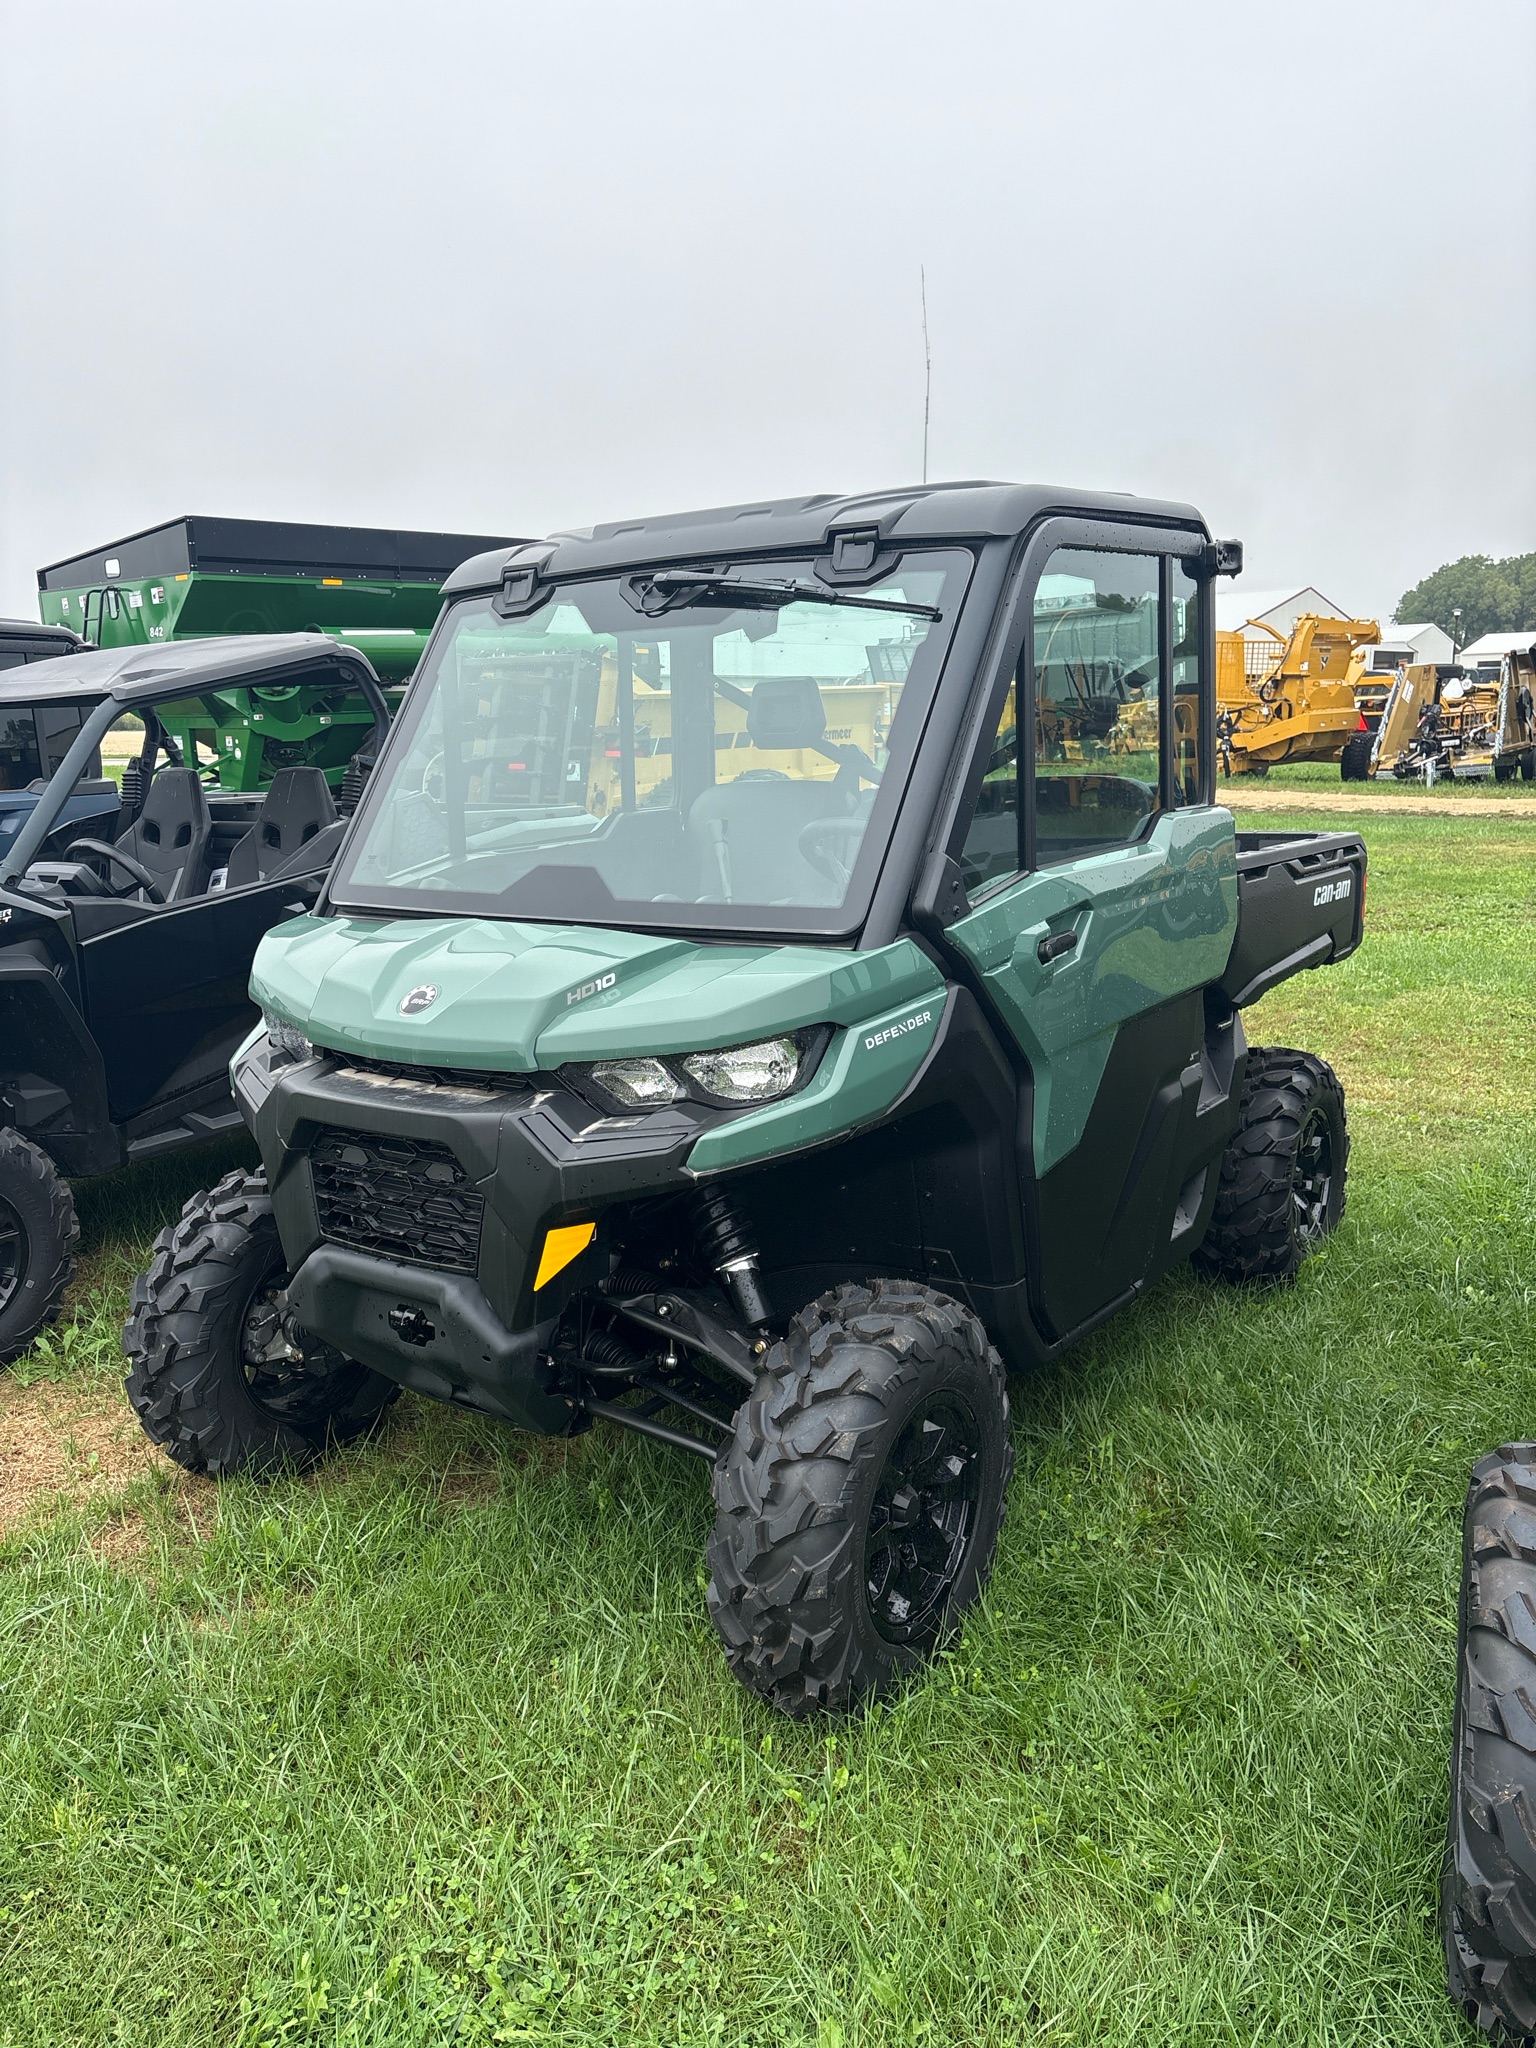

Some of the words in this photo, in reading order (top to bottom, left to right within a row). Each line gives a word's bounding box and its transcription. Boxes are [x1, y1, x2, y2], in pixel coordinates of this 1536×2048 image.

[149, 626, 163, 638] 842
[824, 728, 852, 740] ermeer
[566, 972, 616, 1006] HD10
[410, 997, 431, 1006] BRP
[864, 1011, 932, 1050] DEFENDER
